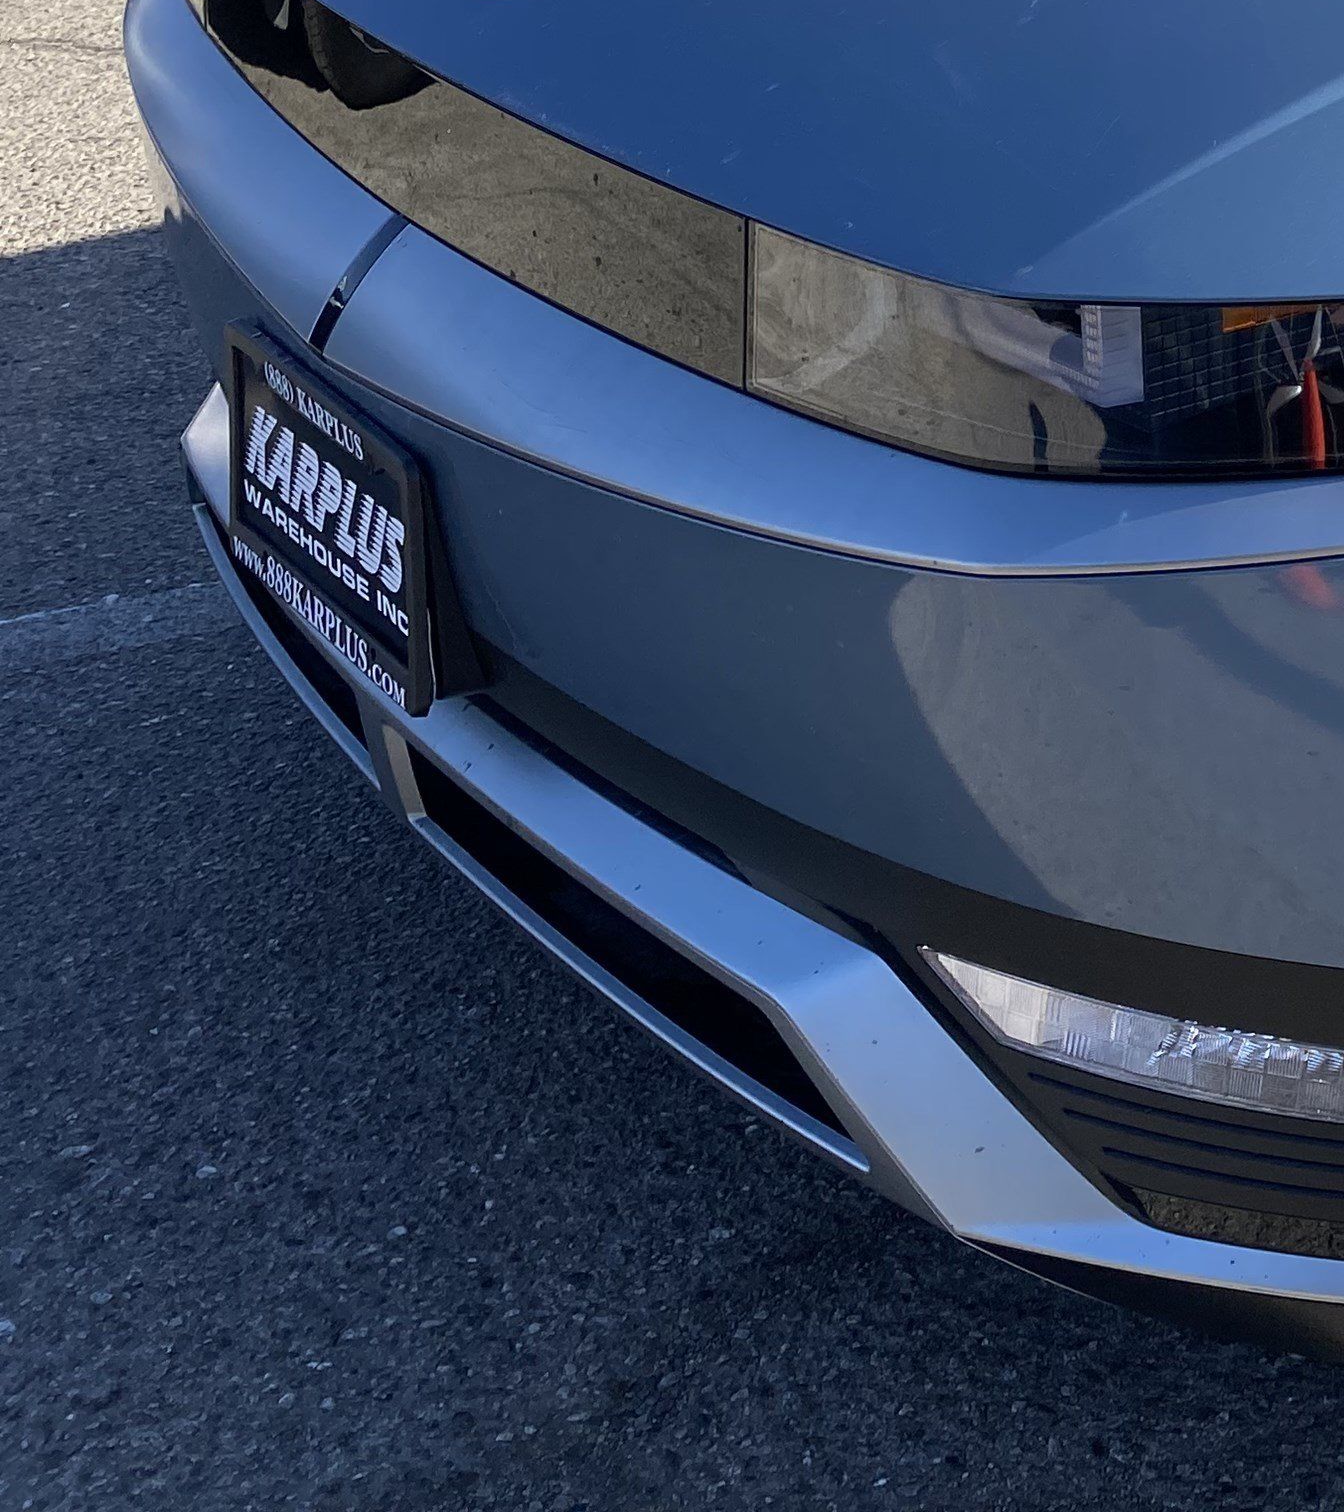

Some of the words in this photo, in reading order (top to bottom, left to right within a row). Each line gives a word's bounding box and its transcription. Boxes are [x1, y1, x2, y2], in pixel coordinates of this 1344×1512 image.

[263, 360, 295, 402] (888)
[297, 386, 365, 461] KARPLUS
[244, 404, 405, 593] KARPLUS
[244, 479, 370, 602] WAREHOUSE
